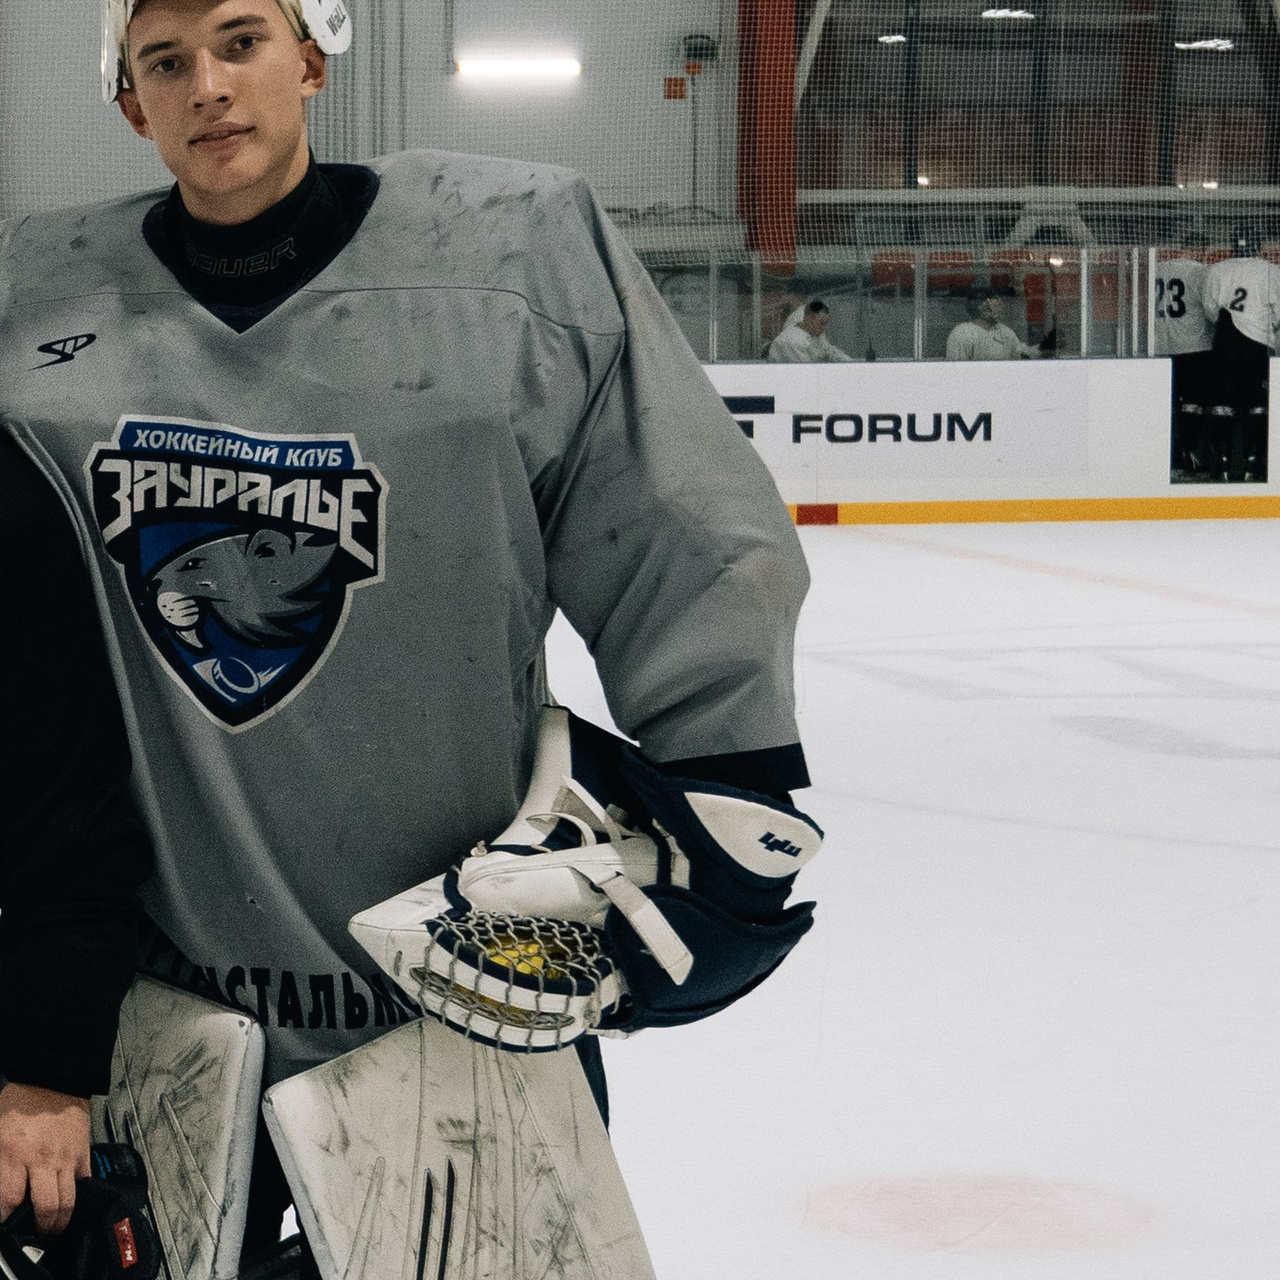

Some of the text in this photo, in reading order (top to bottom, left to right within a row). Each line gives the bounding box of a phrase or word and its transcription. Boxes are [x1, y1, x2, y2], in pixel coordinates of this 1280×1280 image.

[1229, 287, 1248, 313] 2
[791, 411, 993, 444] FORUM
[132, 428, 344, 468] ХОККЕЙНЫЙ КЛУБ
[97, 458, 375, 571] ЗАУРАЛЬЕ
